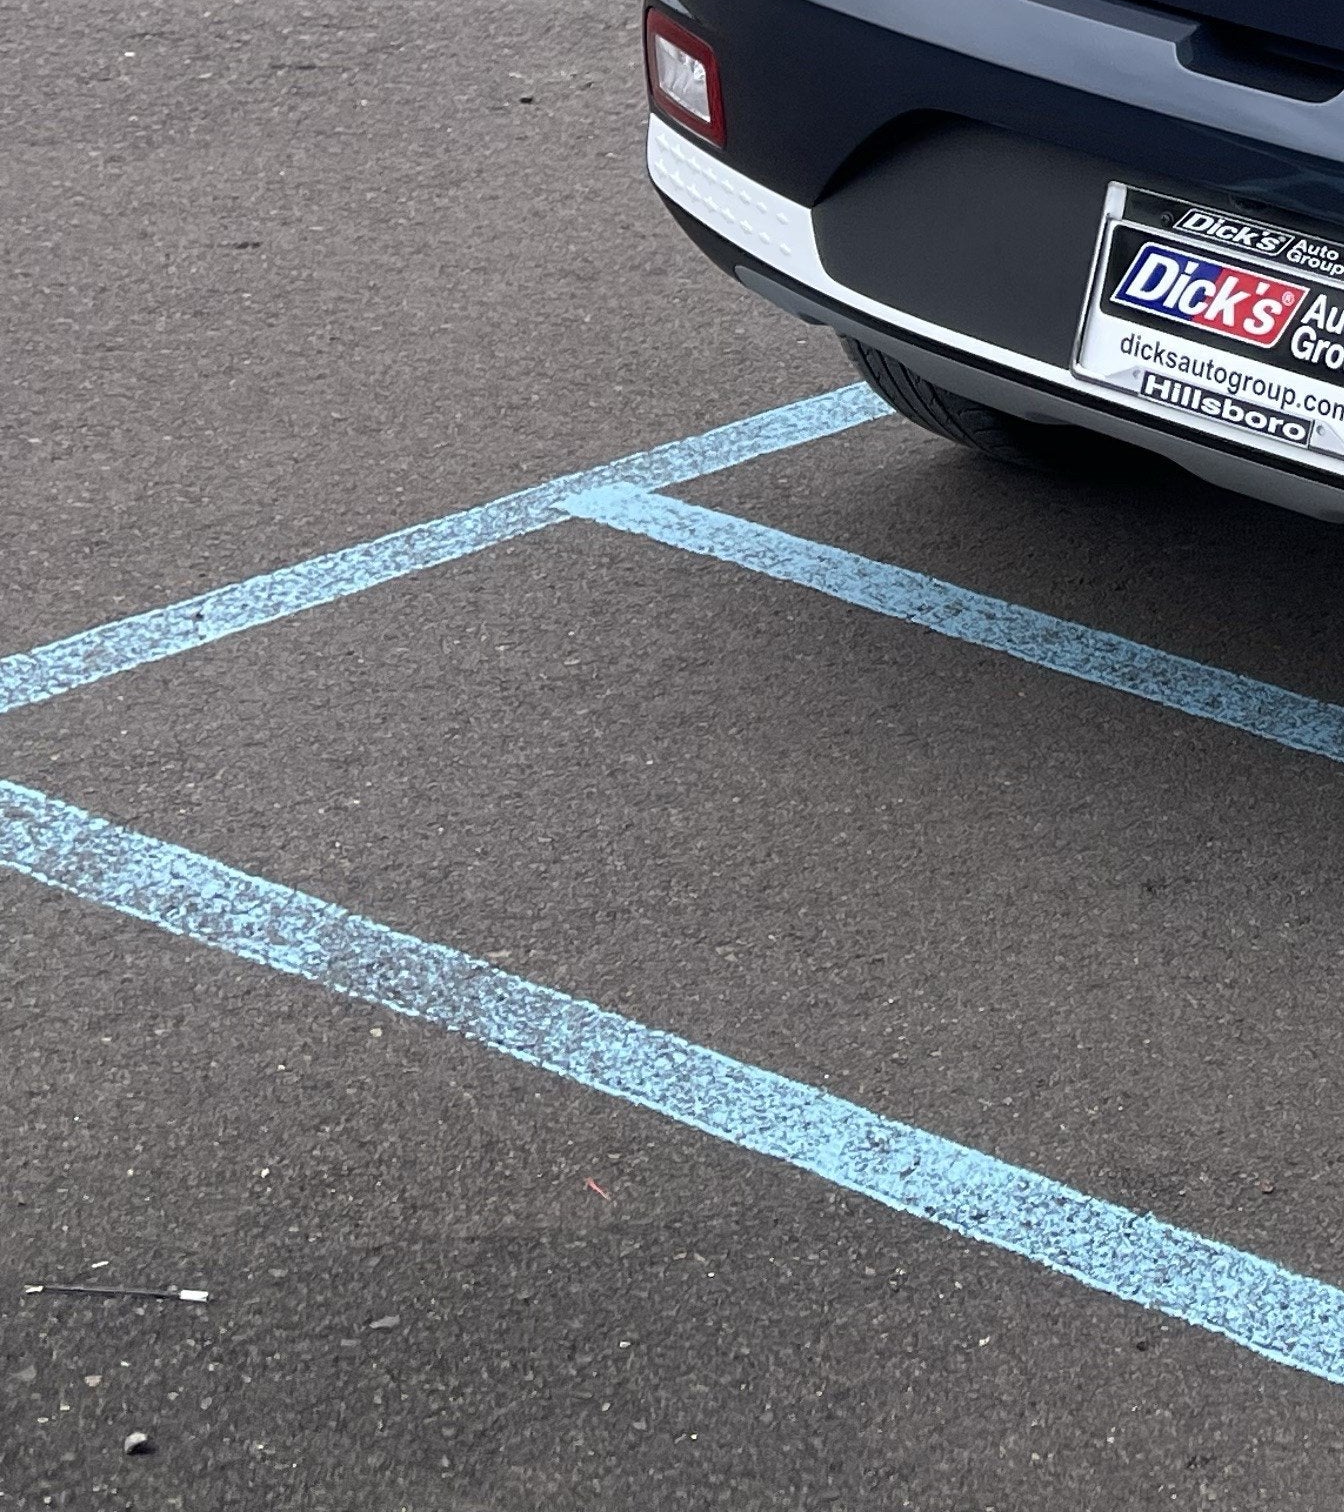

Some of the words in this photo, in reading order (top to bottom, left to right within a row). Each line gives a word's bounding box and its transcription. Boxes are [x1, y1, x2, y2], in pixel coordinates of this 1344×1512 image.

[1182, 211, 1287, 252] Dick's
[1293, 239, 1340, 262] Auto
[1143, 373, 1308, 442] Hillsboro
